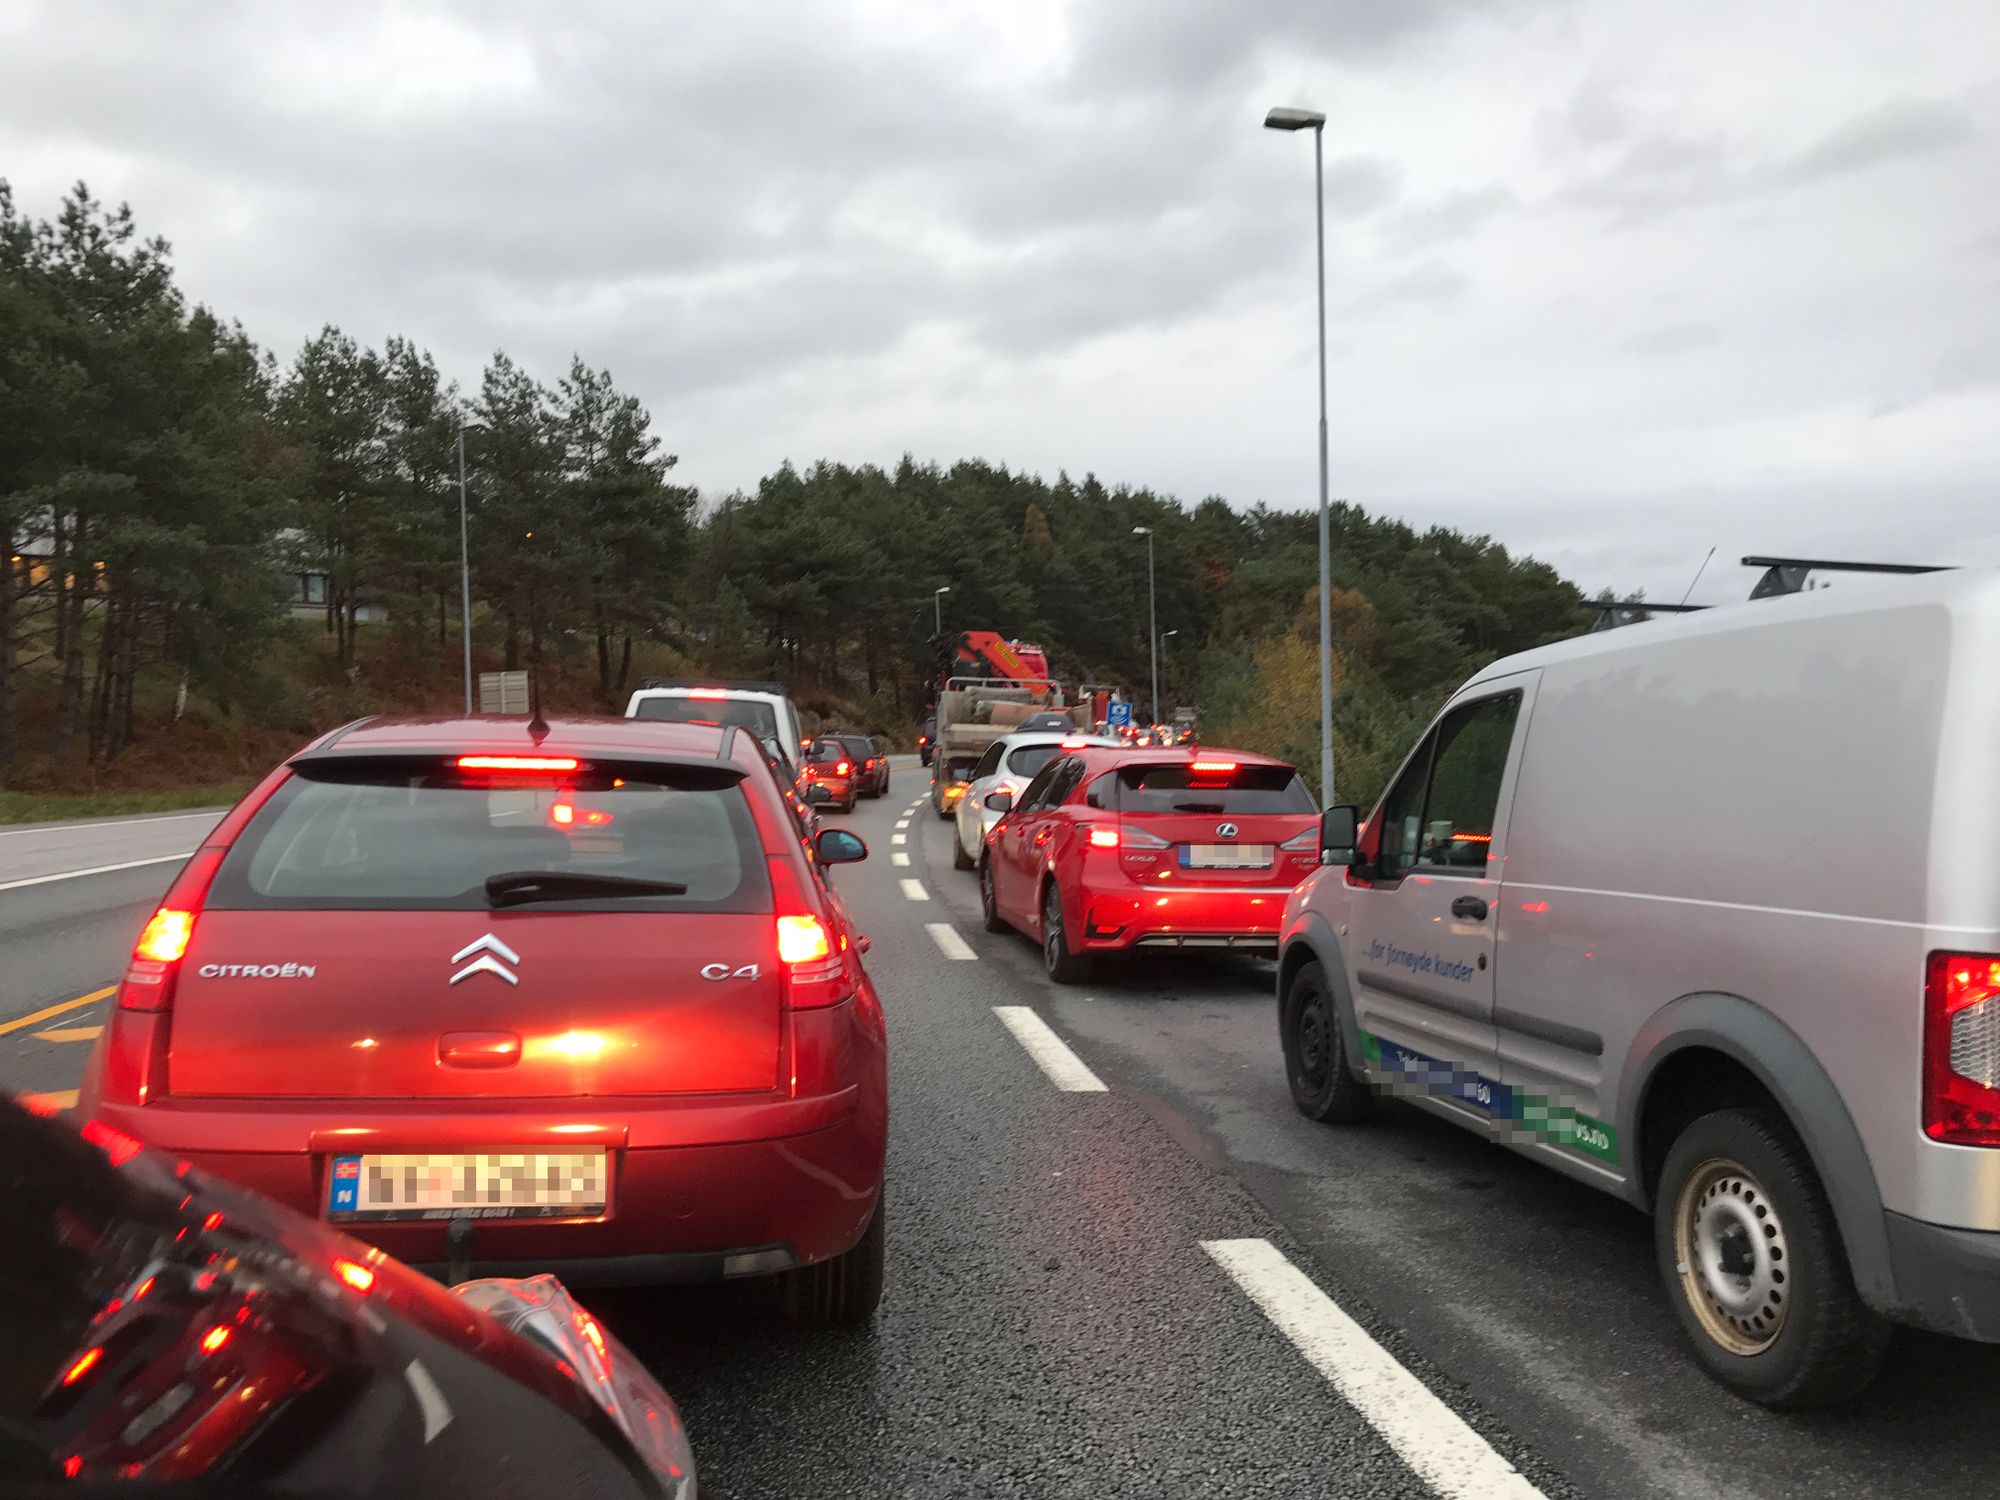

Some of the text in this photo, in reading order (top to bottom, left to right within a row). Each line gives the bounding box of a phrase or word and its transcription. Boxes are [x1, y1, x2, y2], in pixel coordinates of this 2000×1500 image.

[198, 962, 317, 979] CITROËN
[699, 962, 762, 982] C4
[1434, 953, 1474, 983] kunder
